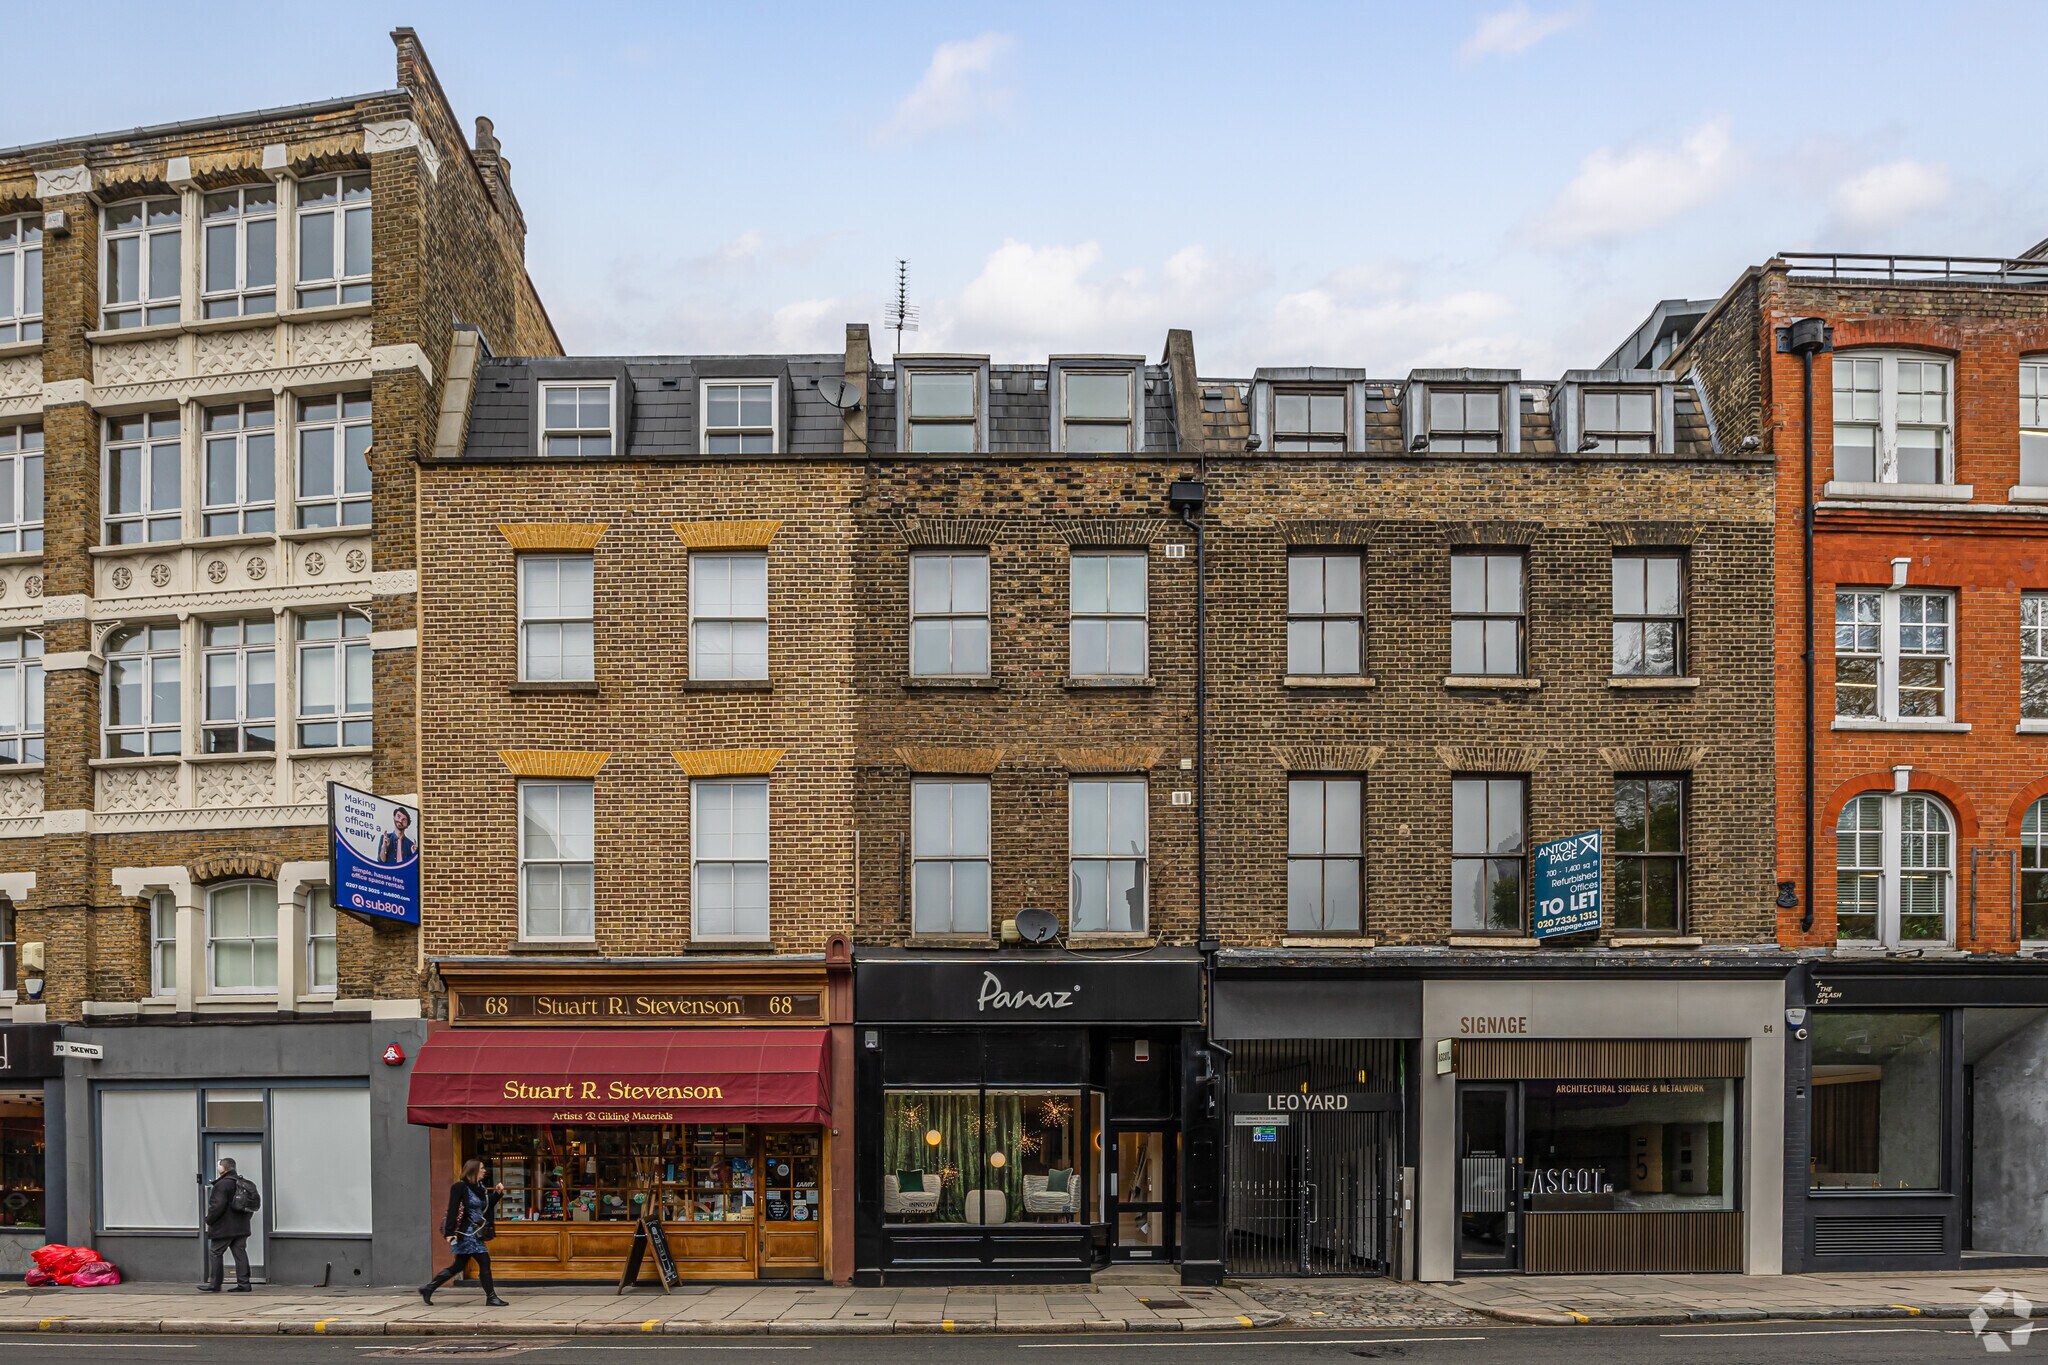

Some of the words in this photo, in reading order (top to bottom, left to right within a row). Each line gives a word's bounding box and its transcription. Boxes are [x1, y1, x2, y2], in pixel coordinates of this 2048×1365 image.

[344, 793, 376, 811] Making
[344, 804, 374, 819] dream
[344, 815, 374, 831] offices
[345, 826, 375, 842] reality
[1538, 839, 1577, 858] ANTON
[1550, 849, 1577, 865] PAGE
[352, 866, 373, 877] Simple,
[374, 871, 391, 881] hassle
[393, 875, 404, 884] free
[1546, 869, 1557, 878] 700
[1565, 863, 1581, 873] 1,400
[1551, 870, 1598, 887] Refurbished
[351, 873, 367, 881] office
[368, 876, 385, 886] space
[386, 880, 405, 890] rentals
[1570, 881, 1598, 893] Offices
[383, 891, 411, 902] sub800.com
[1540, 897, 1564, 917] TO
[1570, 890, 1598, 911] LET
[365, 899, 405, 916] sub800
[1537, 919, 1554, 929] 020
[1555, 914, 1577, 926] 7336
[1579, 910, 1598, 921] 1313
[1545, 920, 1598, 933] antonpage.com
[485, 997, 508, 1015] 68
[537, 997, 598, 1015] Stuart
[608, 997, 627, 1015] R.
[635, 996, 741, 1015] Stevenson
[769, 996, 793, 1014] 68
[1460, 1016, 1527, 1034] SIGNAGE
[1763, 1025, 1773, 1033] 64
[70, 1046, 99, 1055] SKEWED
[503, 1081, 574, 1100] Stuart
[581, 1081, 601, 1100] R.
[608, 1081, 724, 1100] Stevenson
[1556, 1084, 1617, 1093] ARCHITECTURAL
[1618, 1084, 1650, 1093] SIGNAGE
[1652, 1085, 1658, 1093] &
[1660, 1083, 1705, 1093] METALWORK
[1268, 1094, 1299, 1110] LEO
[1302, 1094, 1348, 1110] YARD
[552, 1111, 582, 1121] Artists
[585, 1112, 596, 1121] &
[598, 1111, 630, 1122] Gilding
[632, 1111, 673, 1121] Materials
[1636, 1153, 1647, 1180] 5
